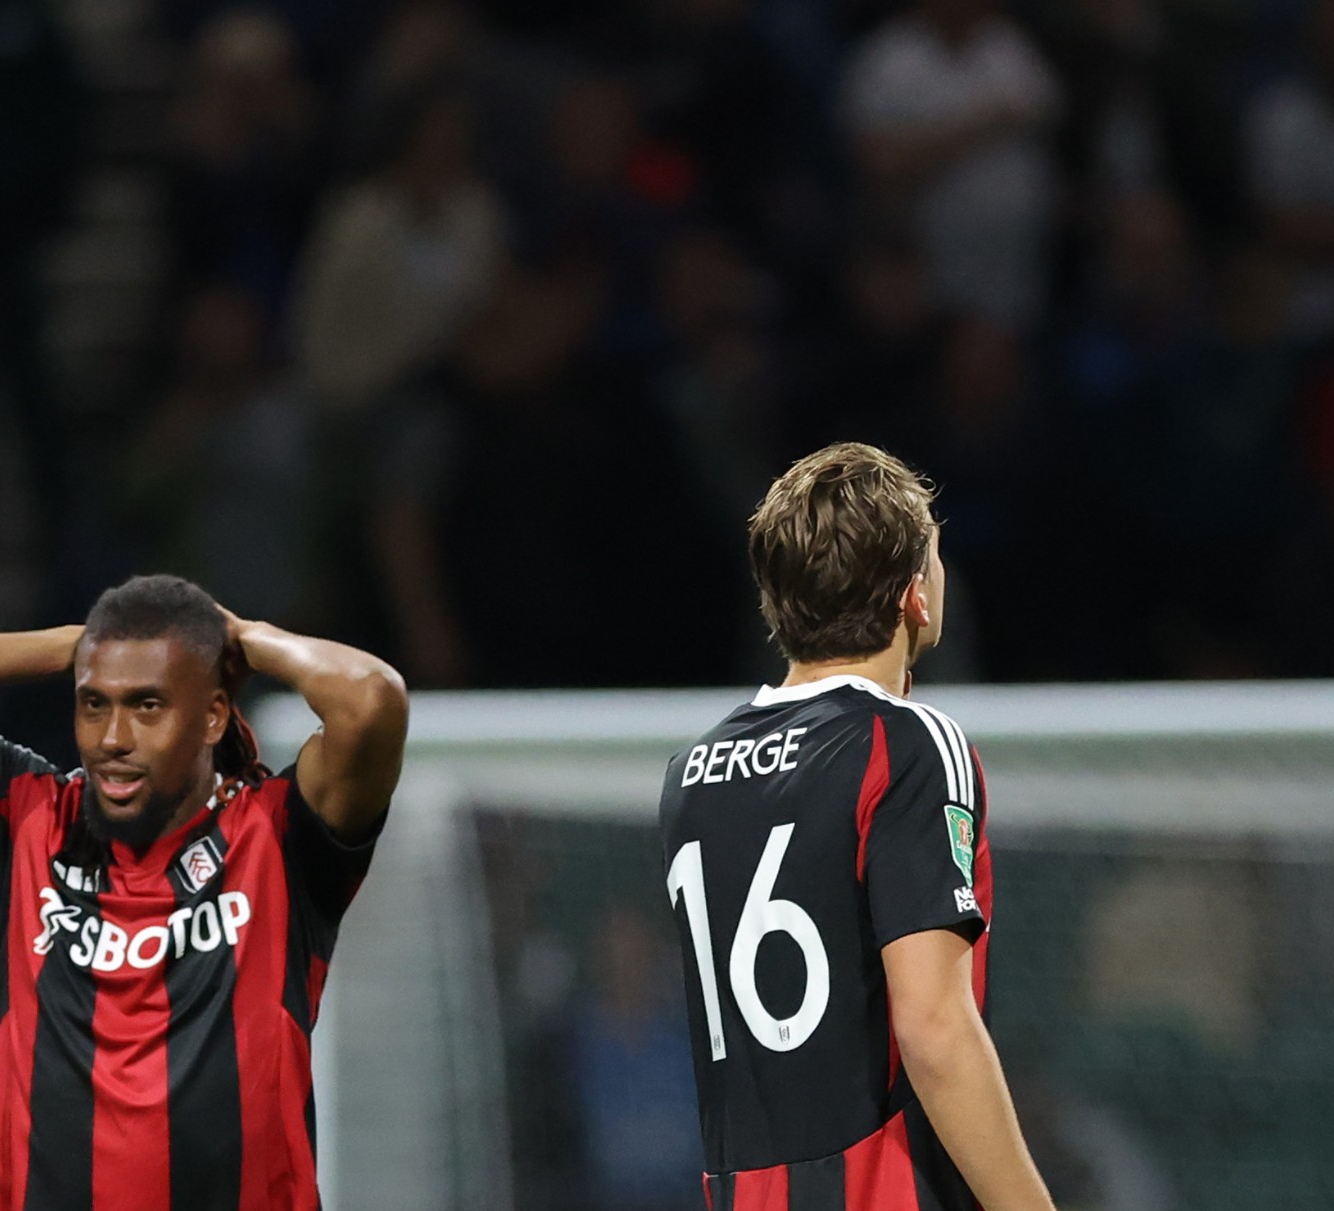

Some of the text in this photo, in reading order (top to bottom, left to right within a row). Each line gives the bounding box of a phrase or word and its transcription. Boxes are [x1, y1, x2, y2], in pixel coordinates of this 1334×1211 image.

[681, 727, 808, 788] BERGE
[69, 891, 252, 972] SBOTOP
[666, 822, 831, 1062] 16
